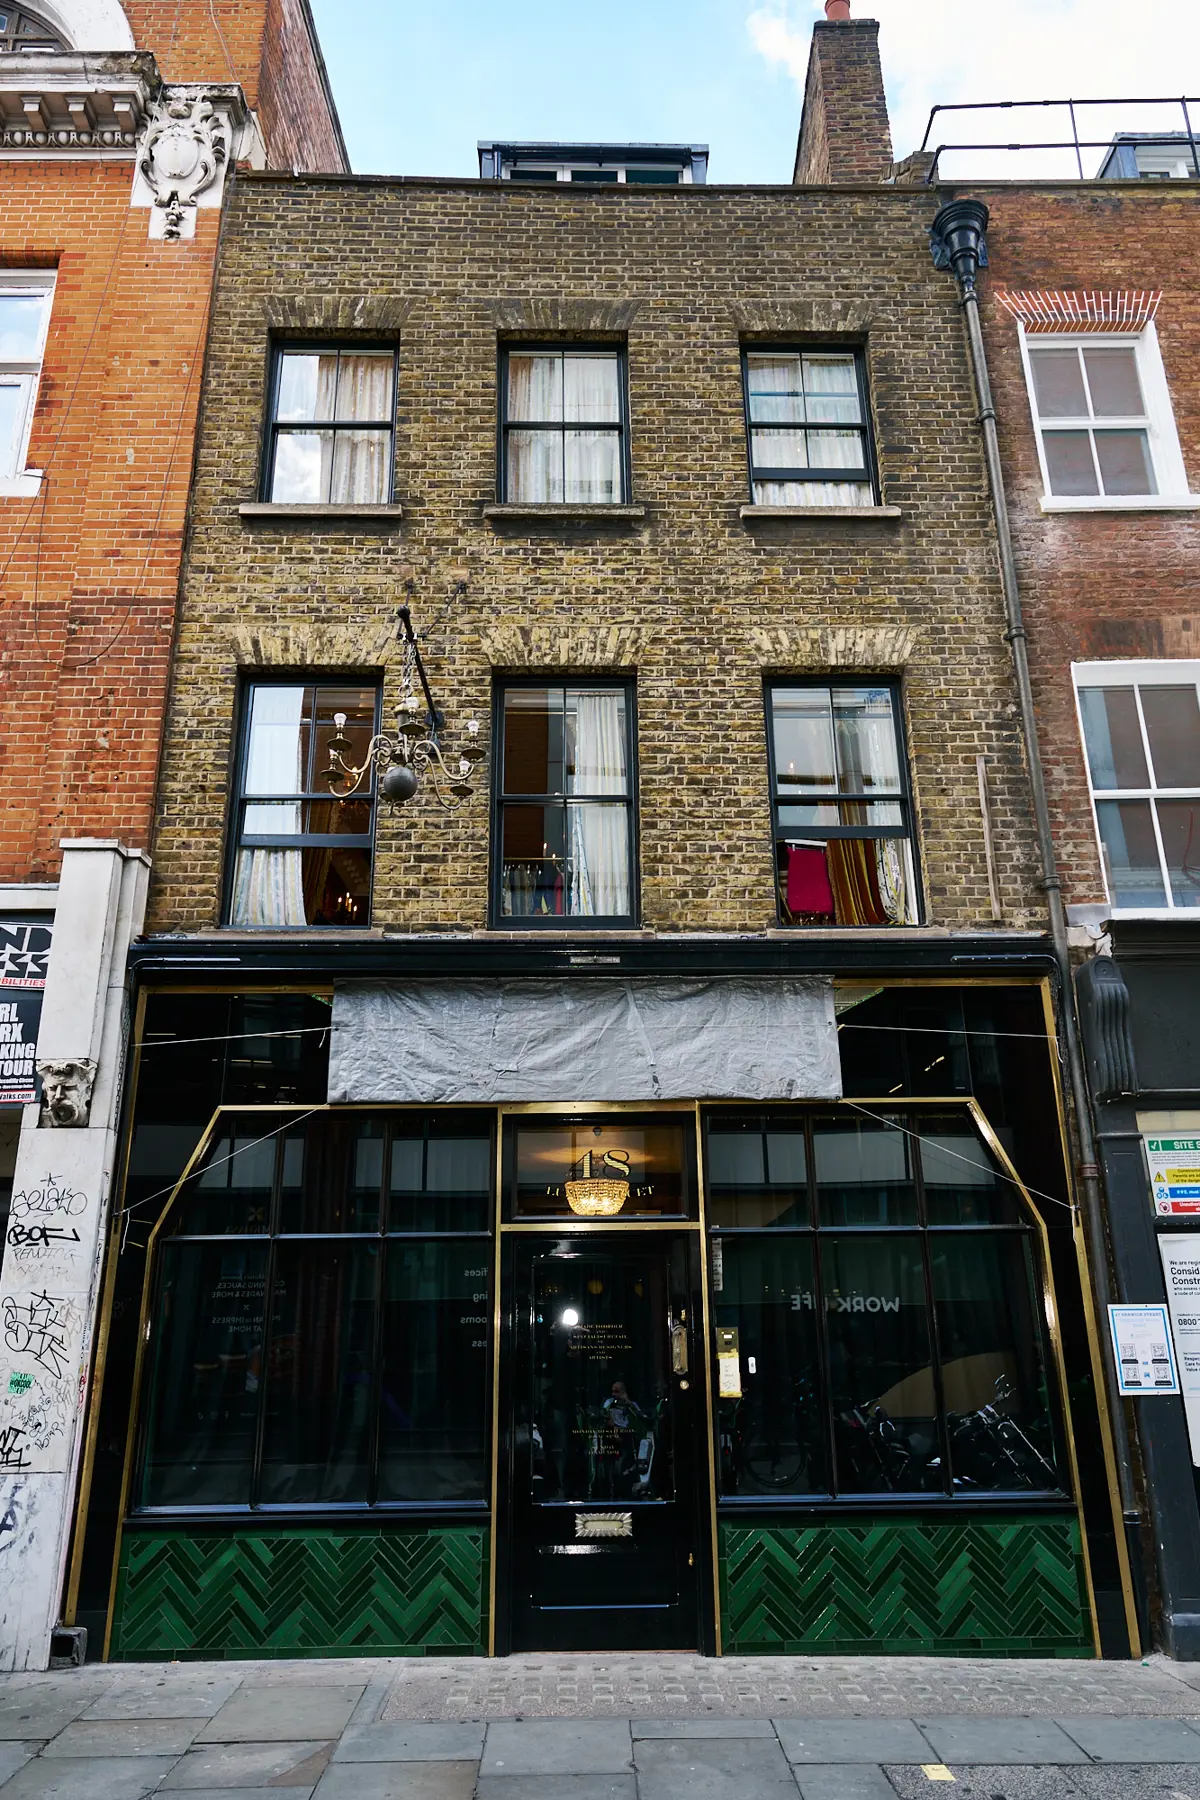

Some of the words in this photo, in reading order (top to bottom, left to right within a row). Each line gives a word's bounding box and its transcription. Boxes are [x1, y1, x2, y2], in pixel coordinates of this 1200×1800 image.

[0, 977, 46, 986] BILITIES
[0, 1043, 36, 1060] KING
[1173, 1141, 1194, 1149] SITE
[569, 1149, 631, 1178] 48
[1178, 1318, 1197, 1326] 0800
